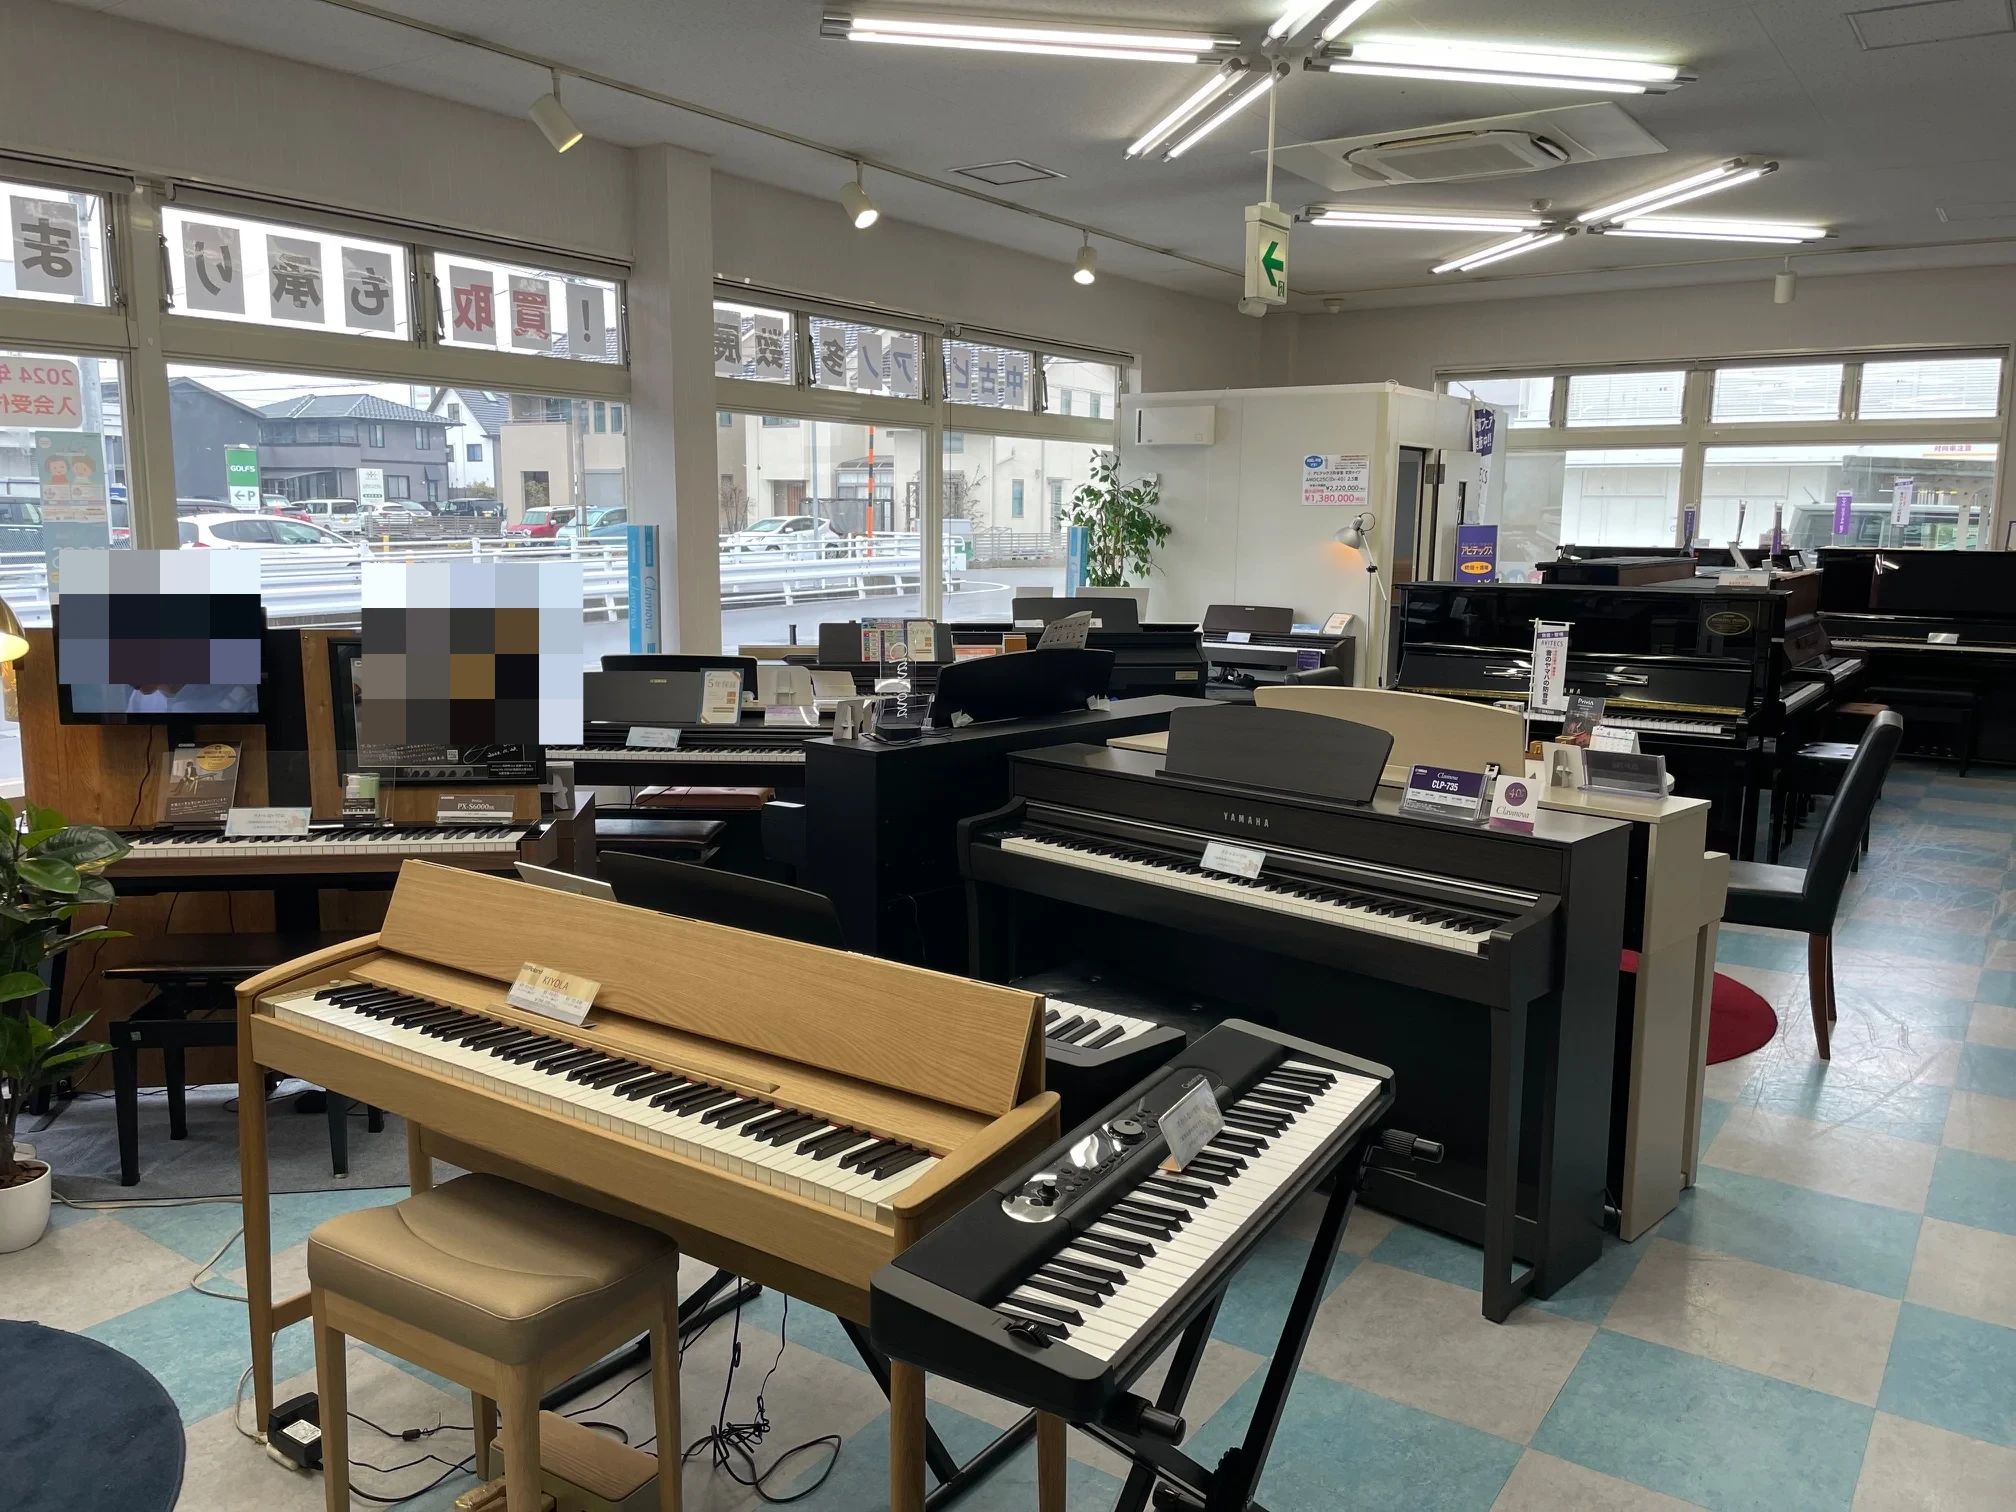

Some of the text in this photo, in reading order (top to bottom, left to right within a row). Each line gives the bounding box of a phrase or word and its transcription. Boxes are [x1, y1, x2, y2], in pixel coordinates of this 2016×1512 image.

[248, 490, 256, 501] P
[644, 576, 657, 630] Clavinova
[1431, 780, 1459, 792] CLP-735
[1223, 811, 1269, 828] YAMAHA
[1496, 805, 1530, 819] Clavinova
[542, 975, 569, 991] KIYOLA
